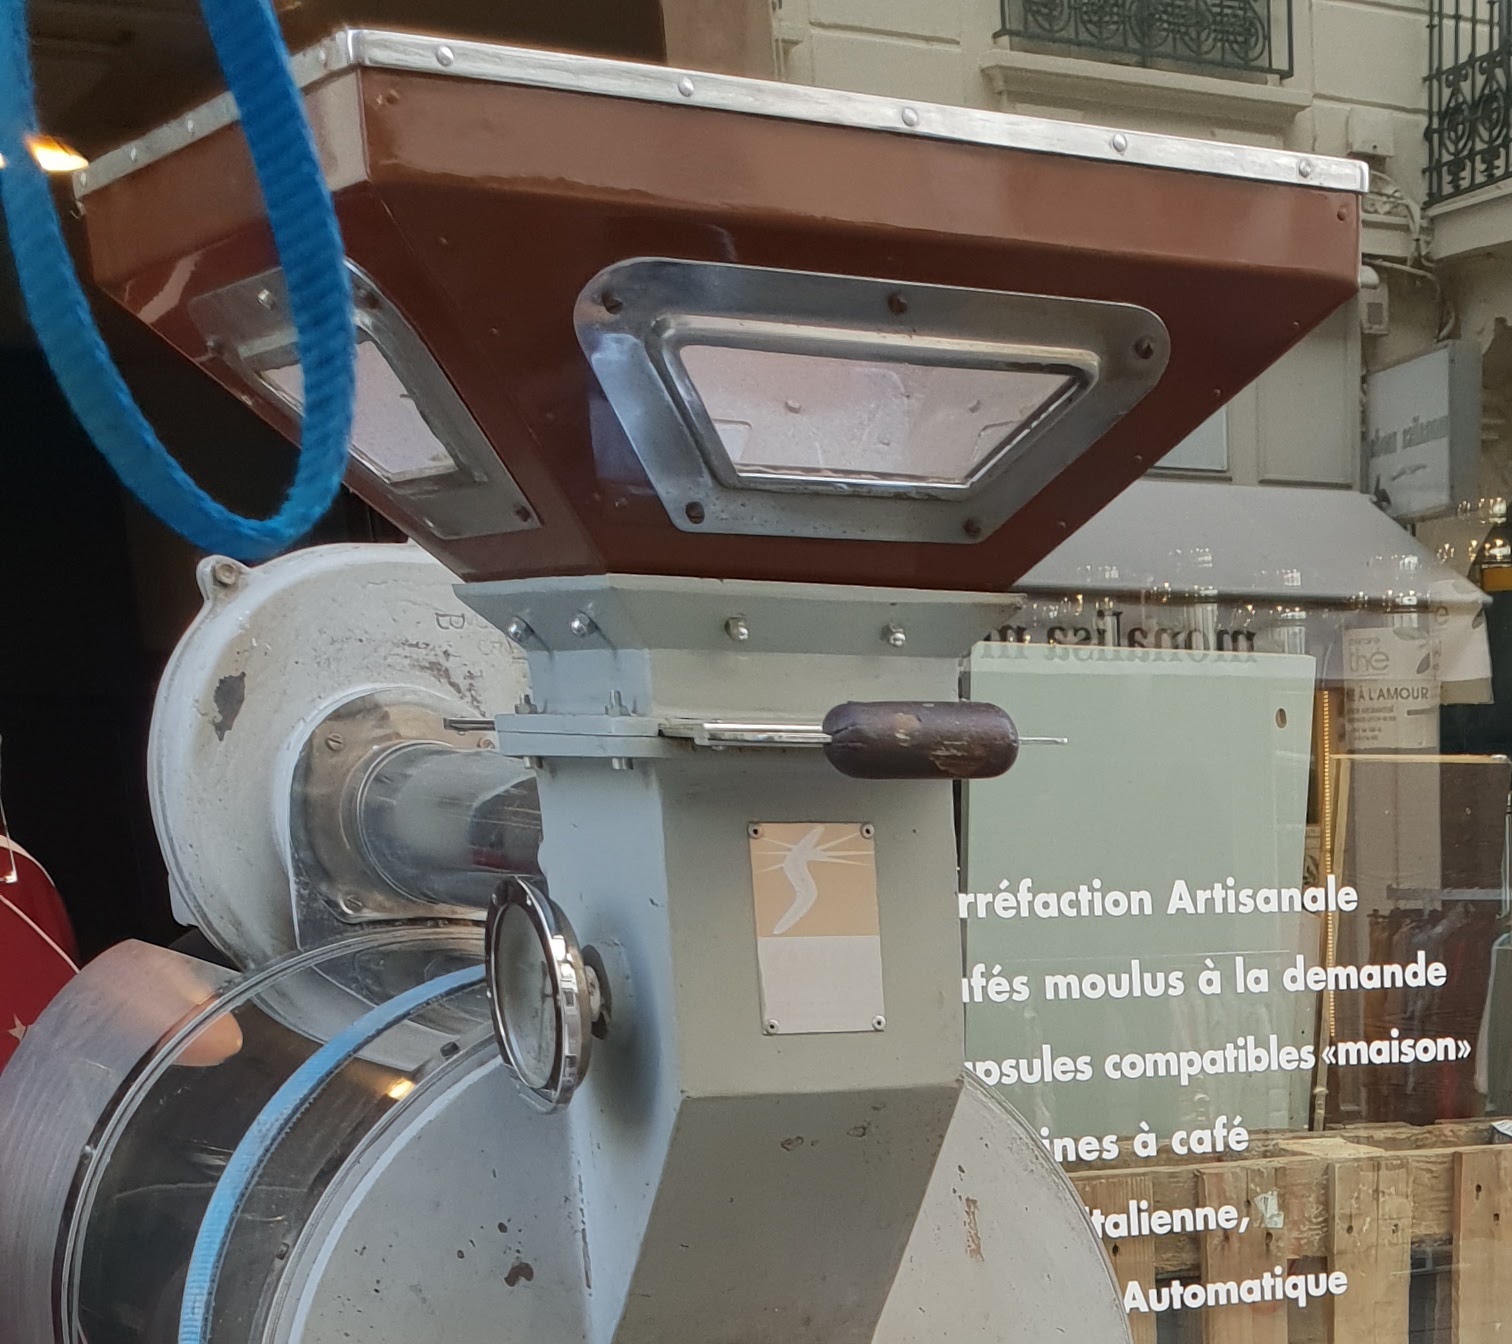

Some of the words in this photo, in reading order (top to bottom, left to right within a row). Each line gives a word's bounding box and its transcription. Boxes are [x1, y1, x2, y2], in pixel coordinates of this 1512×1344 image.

[958, 878, 1153, 919] rréfaction
[1167, 874, 1358, 915] Artisanale
[1044, 959, 1185, 1000] moulus
[1198, 958, 1221, 995] à
[1235, 956, 1269, 994] la
[1282, 950, 1447, 991] demande
[964, 1044, 1094, 1086] psules
[1104, 1034, 1315, 1086] compatibles
[1322, 1028, 1472, 1066] «maison»
[1133, 1121, 1157, 1158] à
[1171, 1115, 1249, 1155] café
[1123, 1267, 1348, 1315] Automatique
